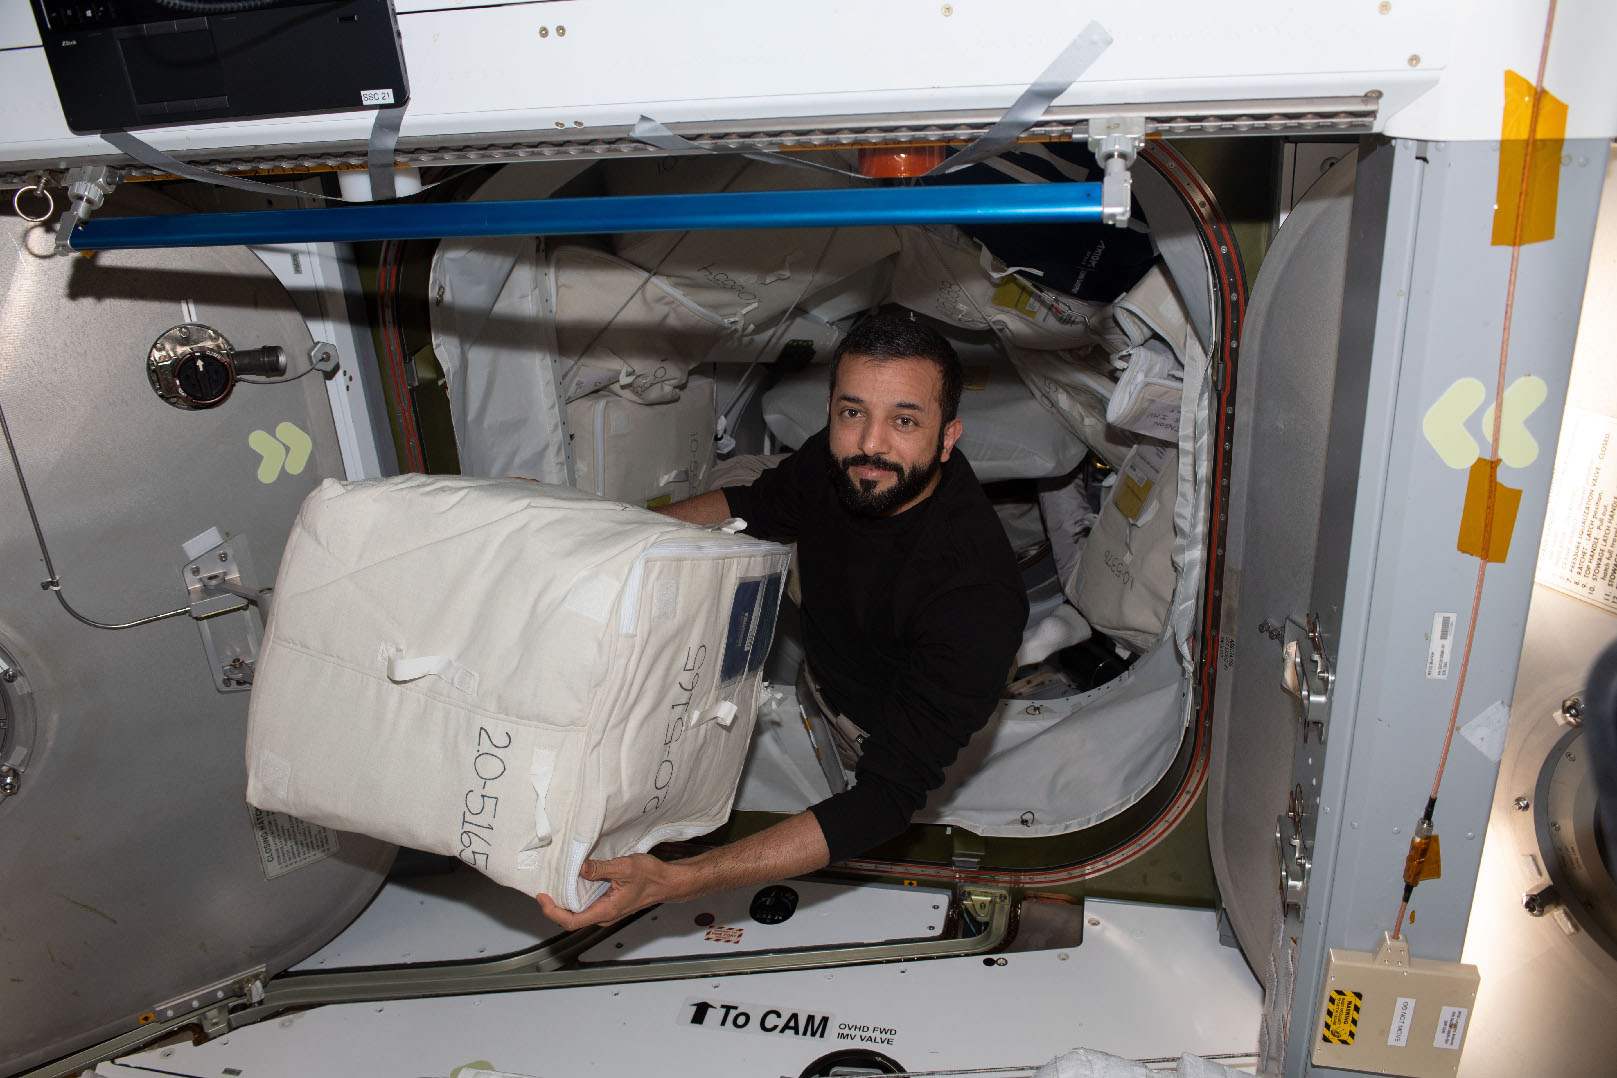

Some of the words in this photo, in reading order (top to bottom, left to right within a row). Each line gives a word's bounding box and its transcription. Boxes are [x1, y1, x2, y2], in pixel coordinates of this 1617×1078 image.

[363, 92, 379, 101] SSC
[381, 91, 390, 100] 21
[1577, 546, 1587, 575] RATCHET
[1585, 520, 1594, 541] LATCH
[1588, 537, 1599, 563] HANDLE
[1592, 548, 1606, 580] STOWAGE
[1602, 526, 1611, 546] LATCH
[458, 727, 512, 870] 2.0-5165
[260, 831, 274, 862] CLOSING
[1344, 1000, 1353, 1025] WARNING
[1399, 1012, 1407, 1025] NOT
[1402, 1001, 1409, 1011] DO
[719, 1004, 750, 1029] To
[760, 1009, 829, 1039] CAM
[838, 1023, 869, 1033] OVHD
[872, 1026, 897, 1036] FWD
[1394, 1025, 1404, 1043] MOVE
[836, 1032, 857, 1041] IMV
[859, 1034, 894, 1046] VALVE
